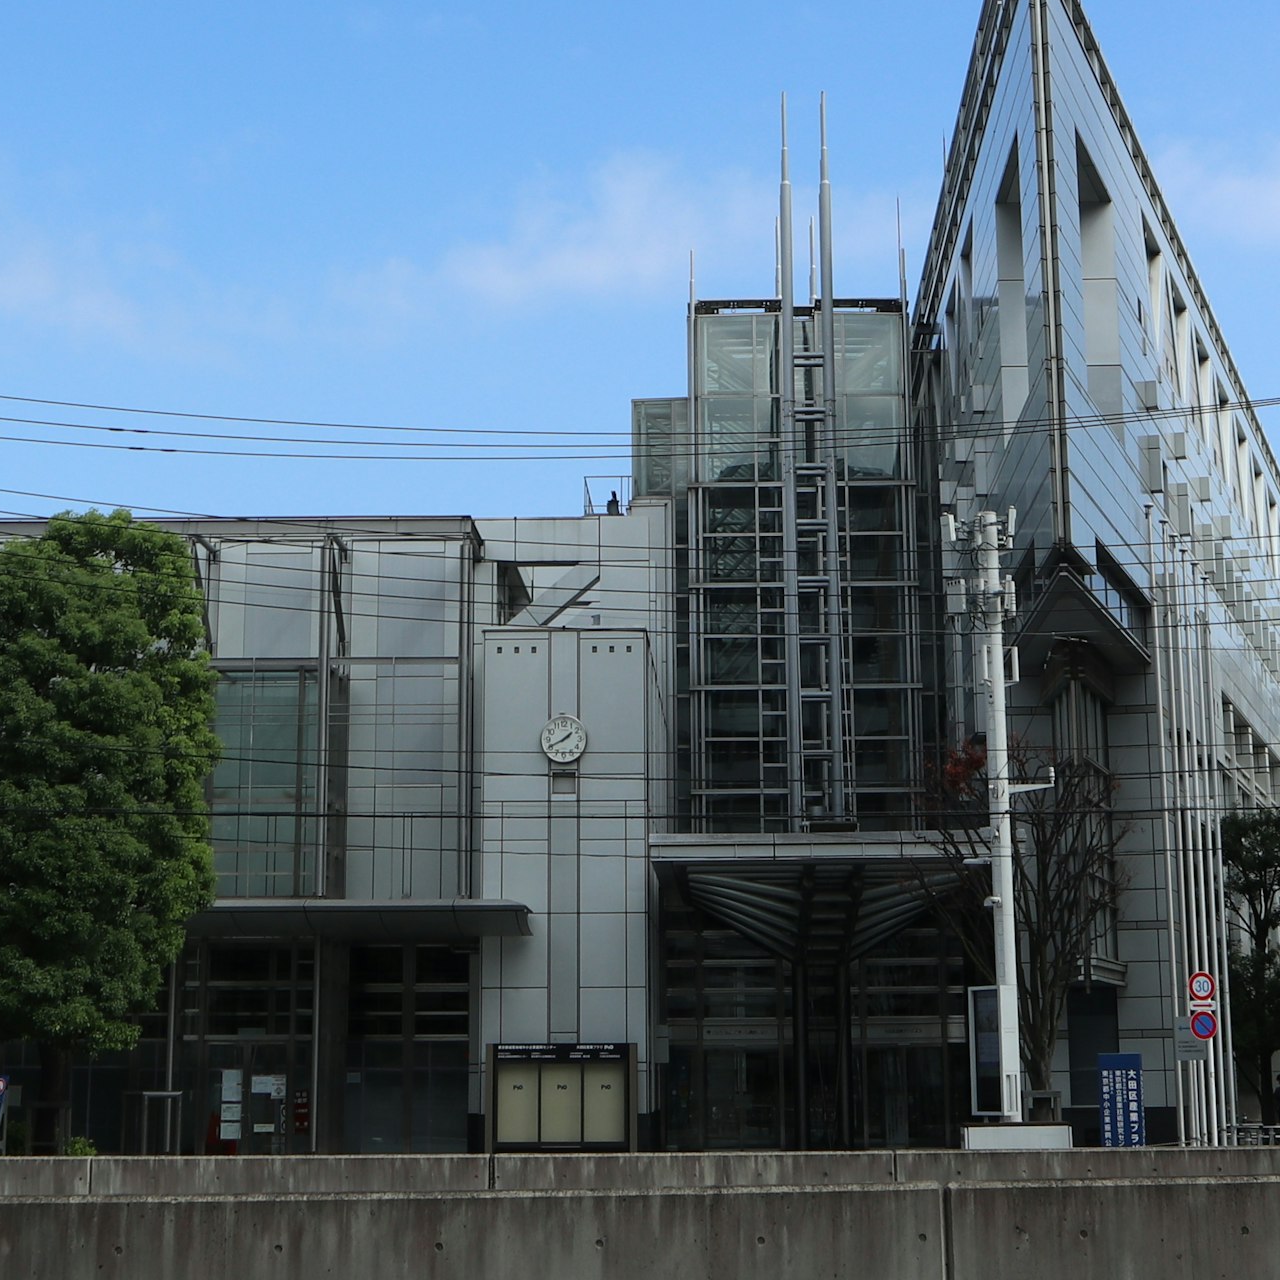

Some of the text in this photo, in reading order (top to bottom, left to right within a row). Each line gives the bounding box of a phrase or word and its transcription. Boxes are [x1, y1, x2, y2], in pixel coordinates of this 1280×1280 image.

[561, 719, 568, 727] 12
[546, 728, 555, 736] 10
[1195, 980, 1210, 993] 30
[1127, 1070, 1140, 1148] 大田区産業プラ
